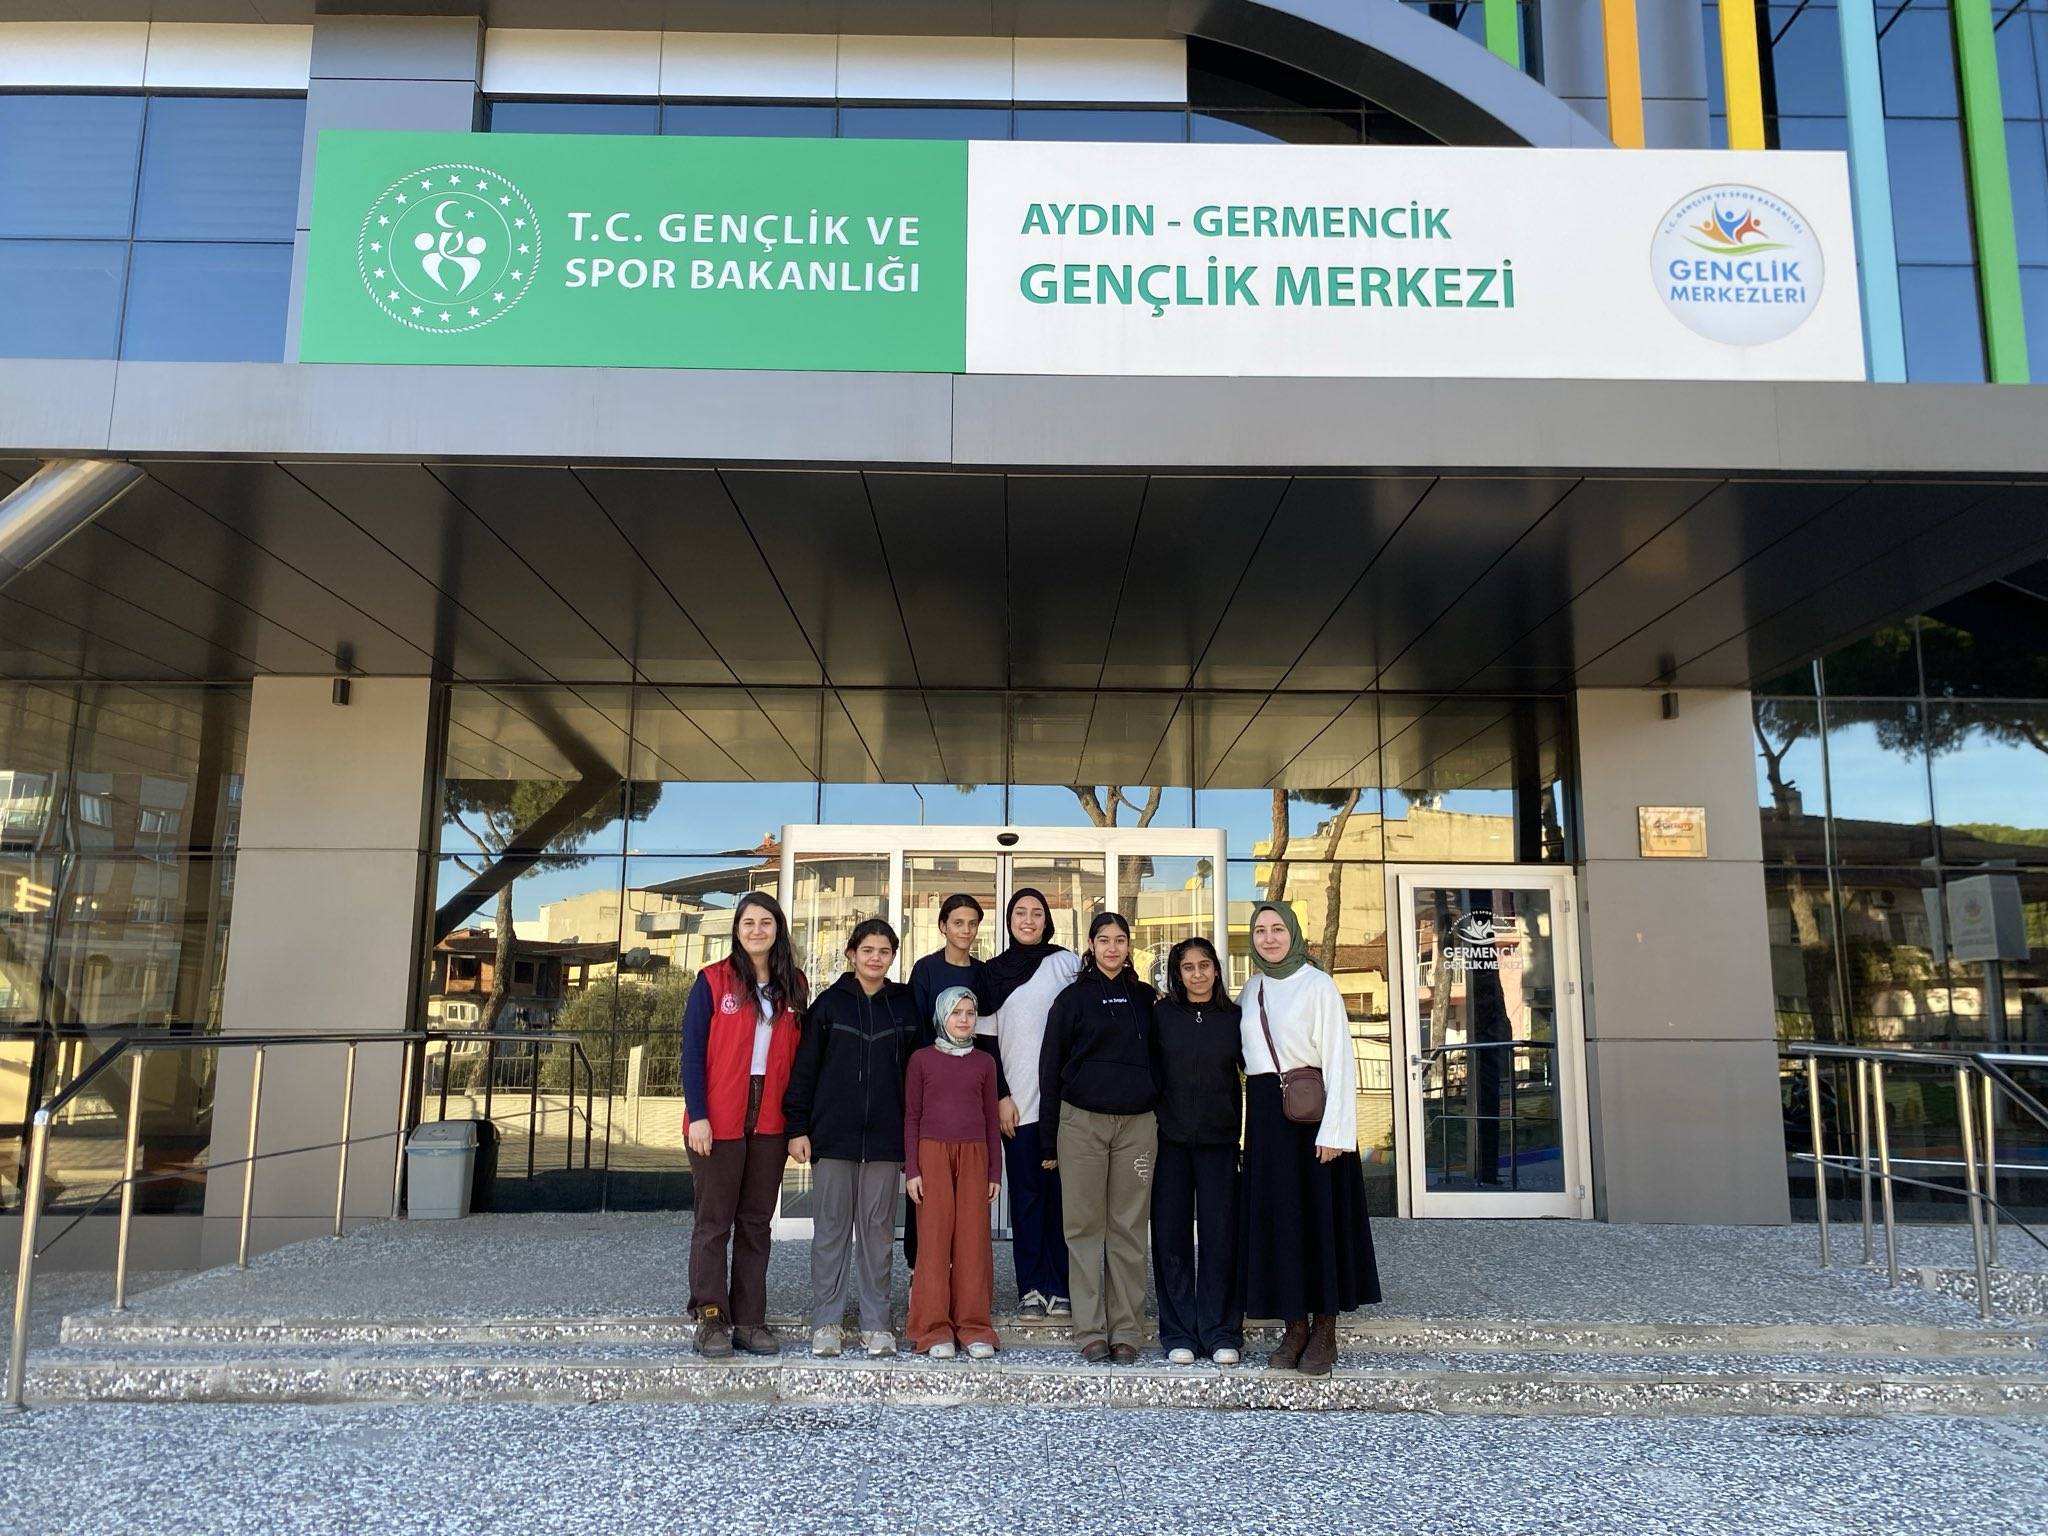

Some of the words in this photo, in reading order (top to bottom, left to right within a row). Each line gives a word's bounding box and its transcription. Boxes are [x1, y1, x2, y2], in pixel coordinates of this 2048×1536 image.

[1715, 191, 1726, 199] VE
[1729, 191, 1755, 200] SPOR
[567, 211, 643, 243] T.C.
[658, 208, 850, 252] GENÇLİK
[866, 216, 921, 246] VE
[1021, 203, 1155, 236] AYDIN
[1193, 200, 1452, 239] GERMENCİK
[564, 256, 676, 289] SPOR
[690, 254, 920, 293] BAKANLIĞI
[1019, 255, 1260, 318] GENÇLİK
[1274, 259, 1516, 309] MERKEZİ
[1668, 259, 1802, 285] GENÇLİK
[1670, 286, 1806, 304] MERKEZLERİ
